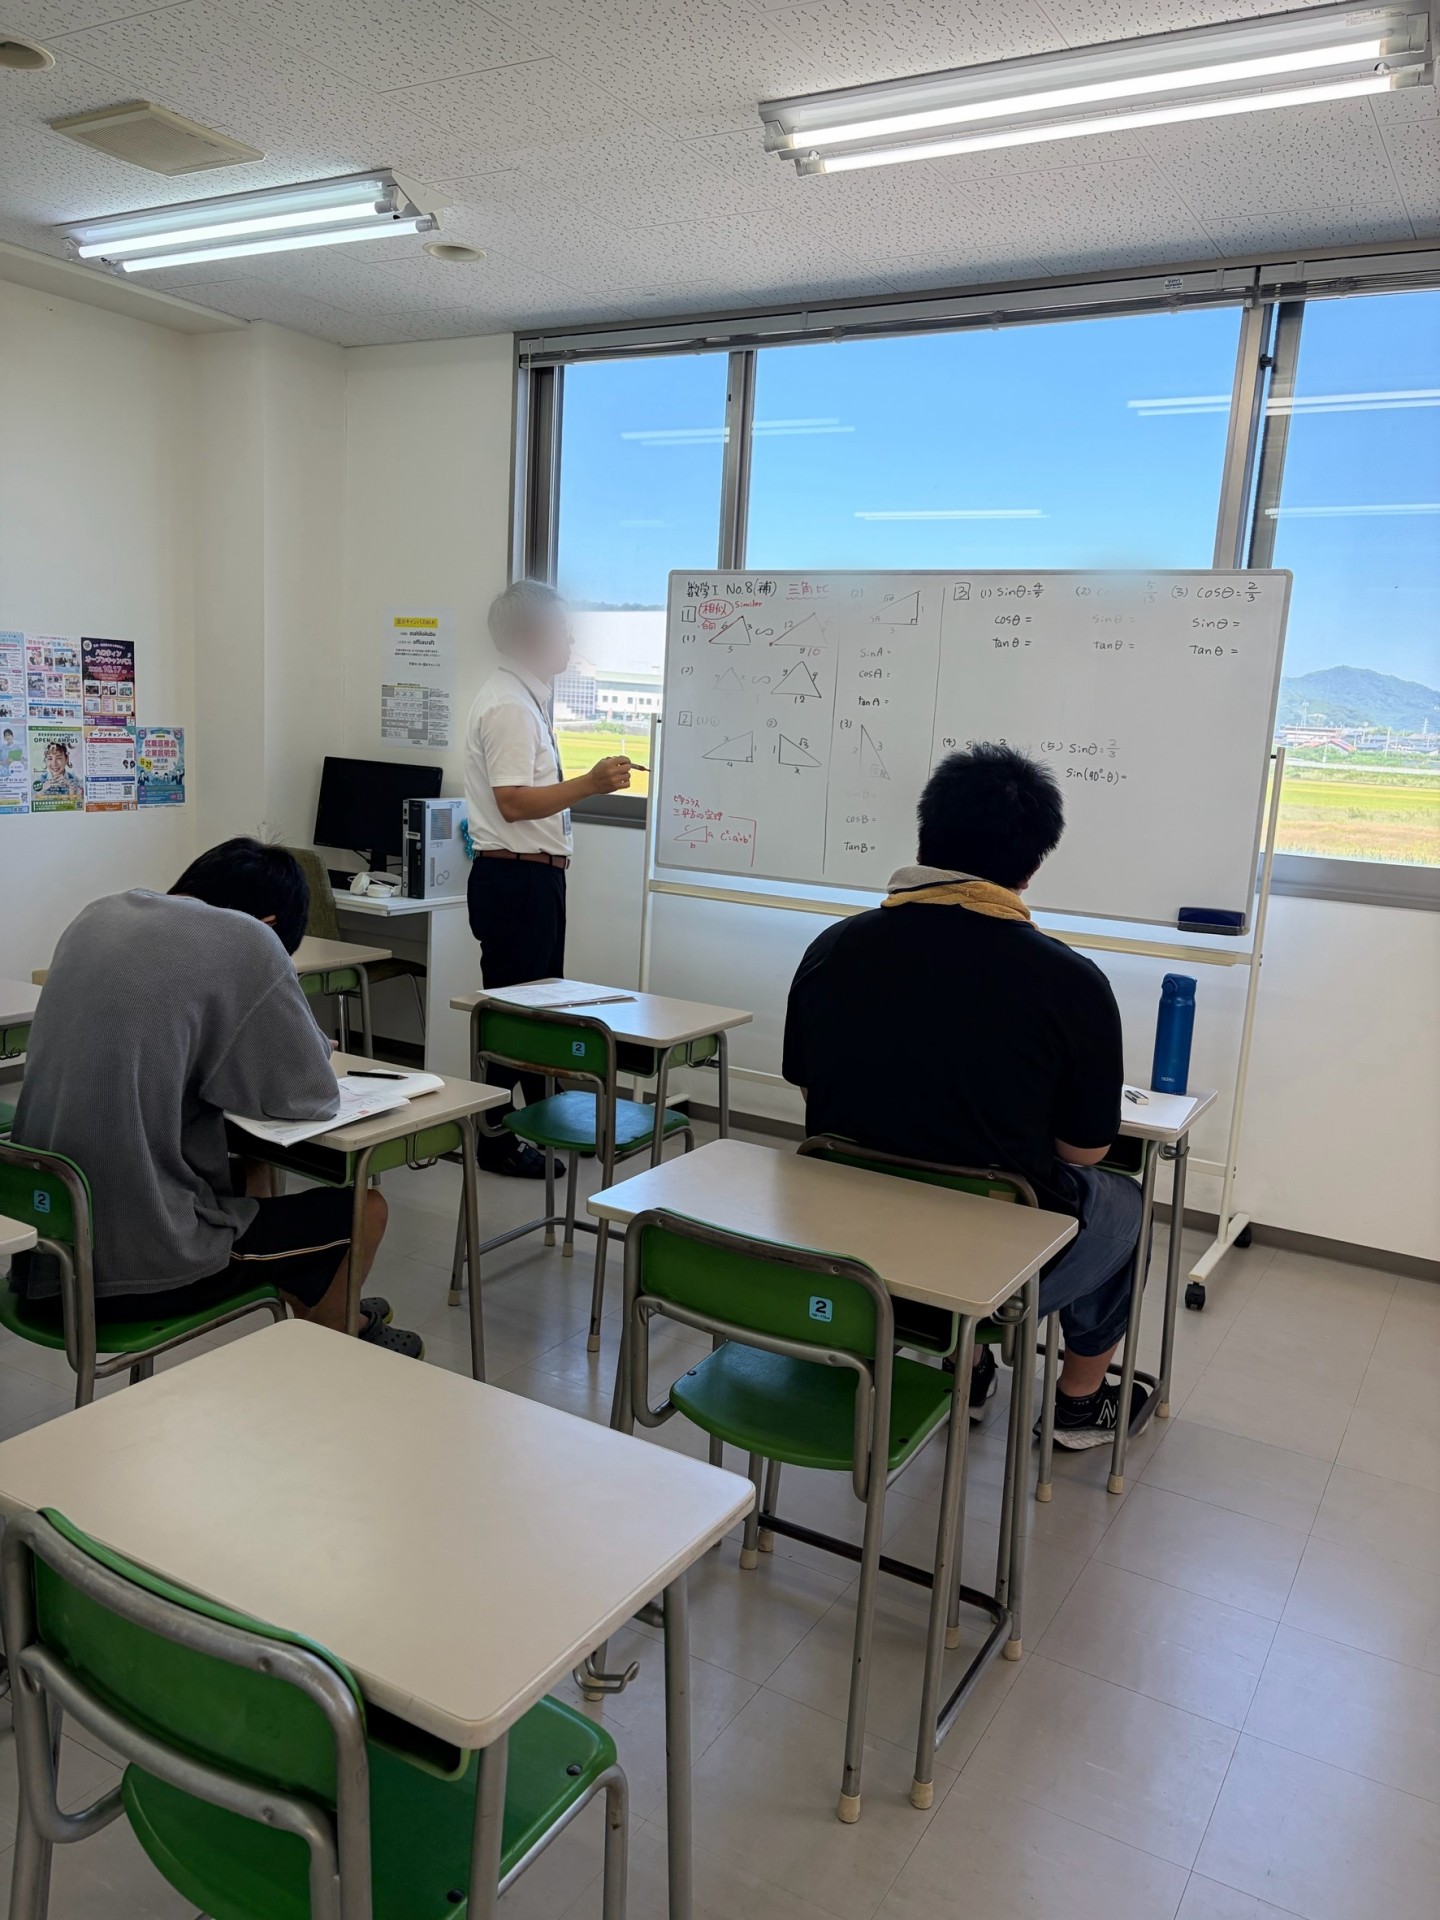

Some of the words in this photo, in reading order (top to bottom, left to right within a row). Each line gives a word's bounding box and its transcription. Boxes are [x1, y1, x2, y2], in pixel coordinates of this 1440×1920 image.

[575, 1043, 582, 1052] 2
[37, 1193, 46, 1206] 2
[815, 1300, 827, 1314] 2
